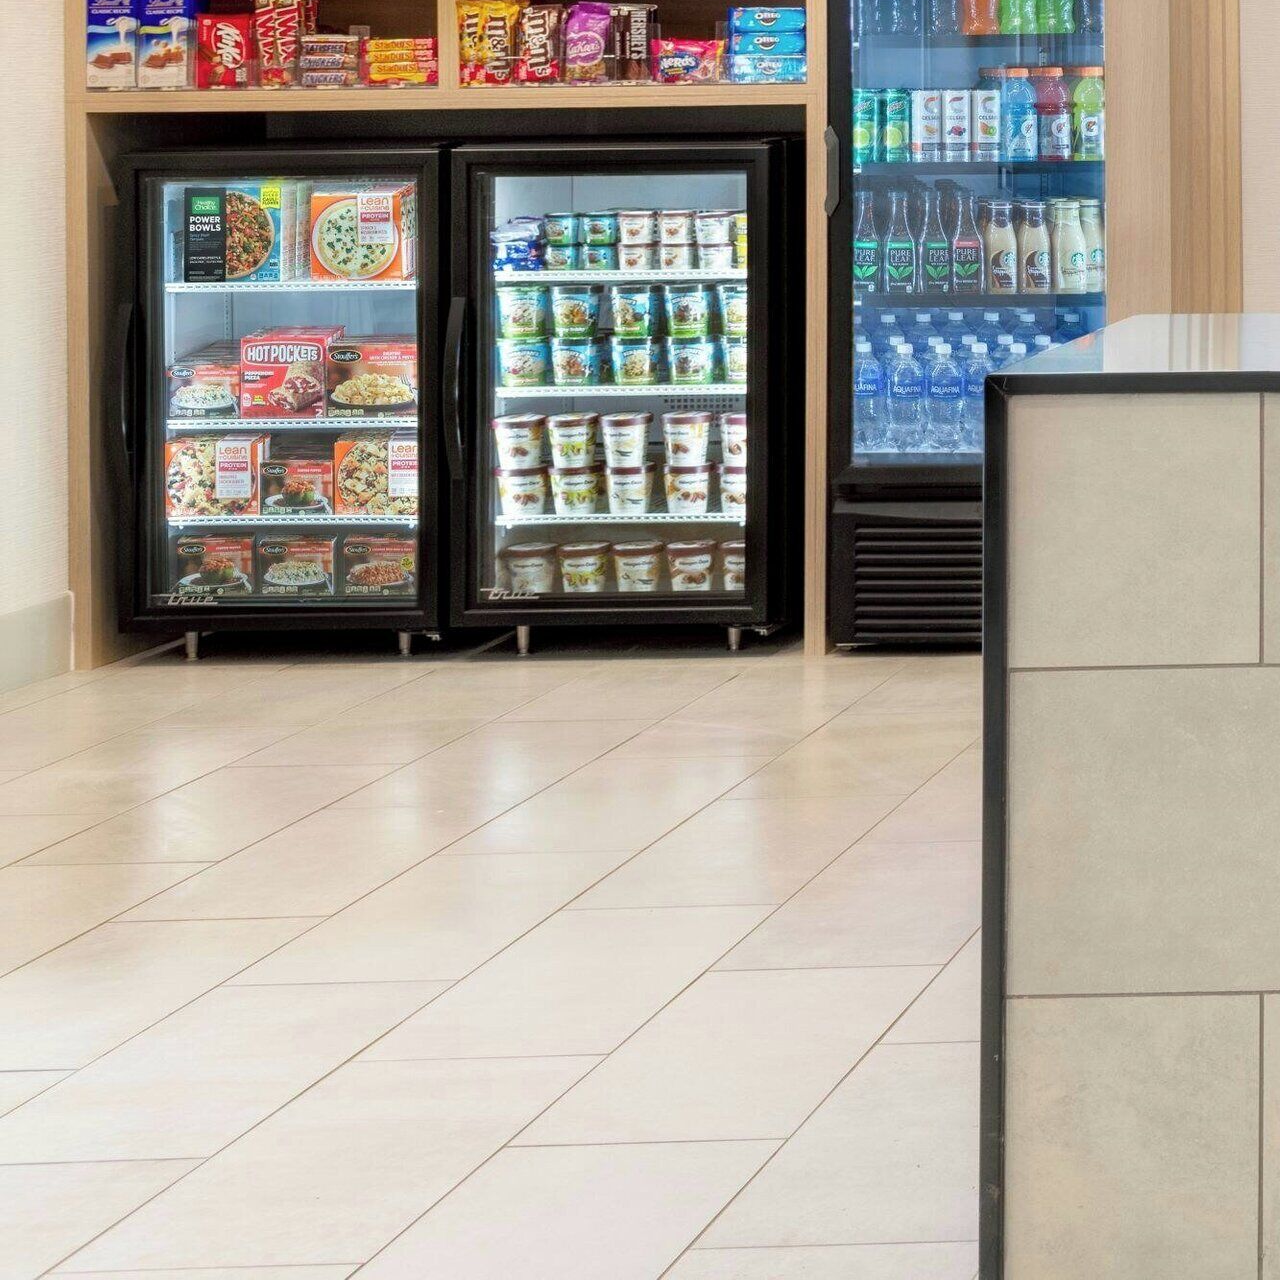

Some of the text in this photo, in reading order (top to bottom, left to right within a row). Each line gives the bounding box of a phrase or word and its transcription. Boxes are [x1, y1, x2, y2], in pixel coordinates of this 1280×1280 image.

[754, 11, 781, 19] OREO
[754, 36, 780, 44] OREO
[304, 73, 344, 83] SNICKERS
[189, 224, 221, 232] BOWLS
[248, 345, 319, 362] HOT POCKETS
[931, 385, 960, 394] AQUAFINA
[220, 447, 247, 455] Lean
